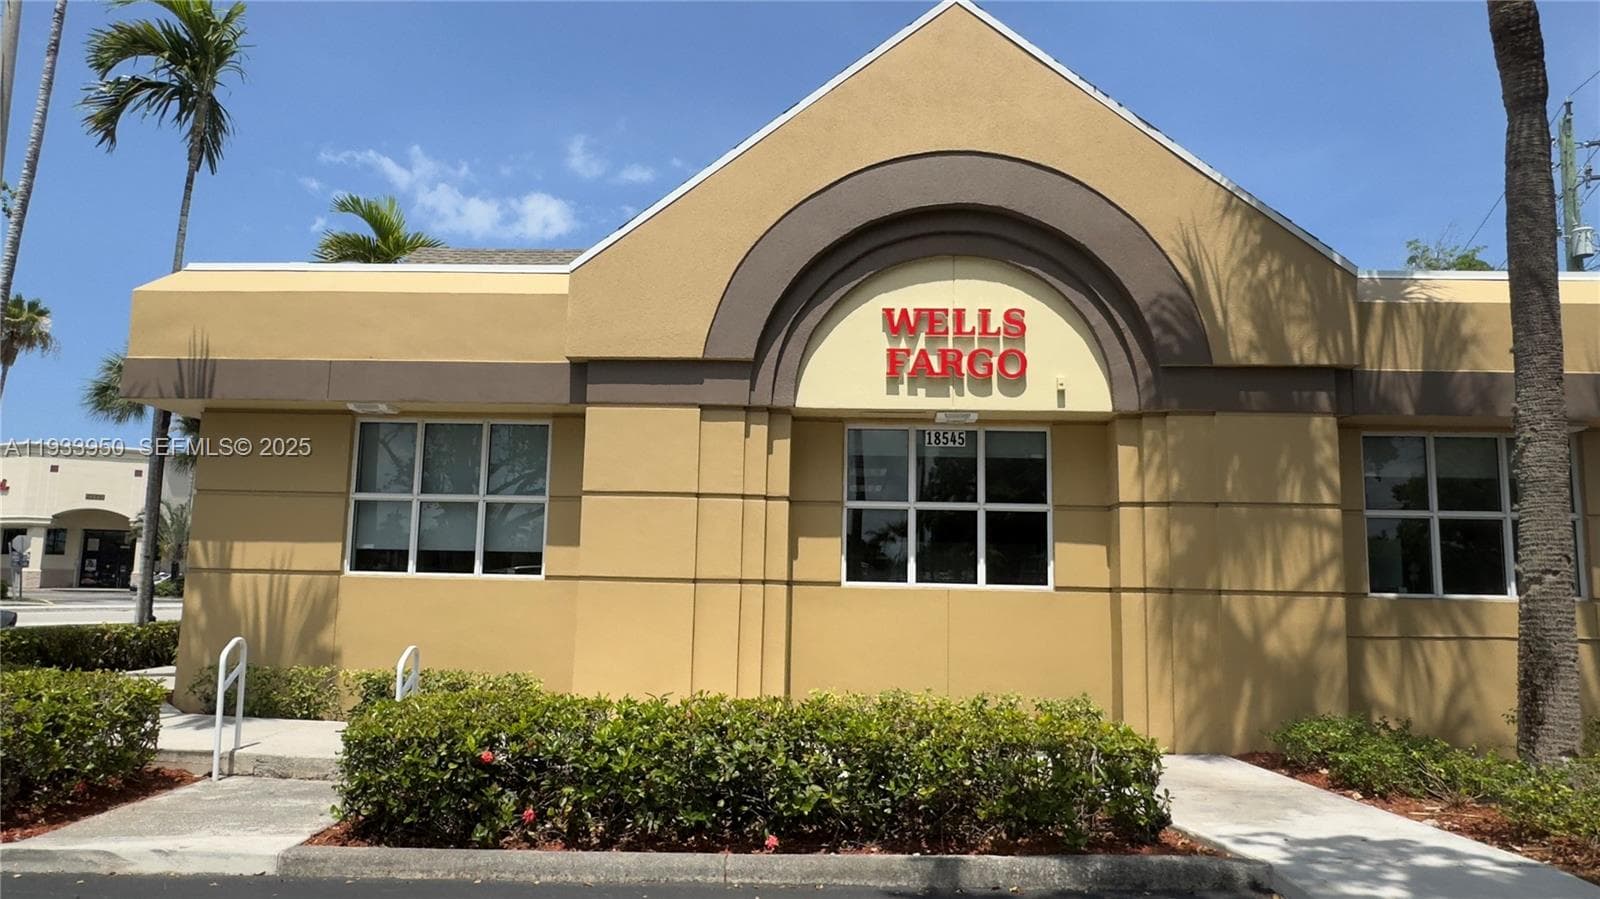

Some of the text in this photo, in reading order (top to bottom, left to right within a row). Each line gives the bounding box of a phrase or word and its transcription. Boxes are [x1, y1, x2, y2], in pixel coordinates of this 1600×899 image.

[882, 307, 1027, 338] WELLS
[886, 347, 1028, 380] FARGO
[926, 431, 965, 446] 18545
